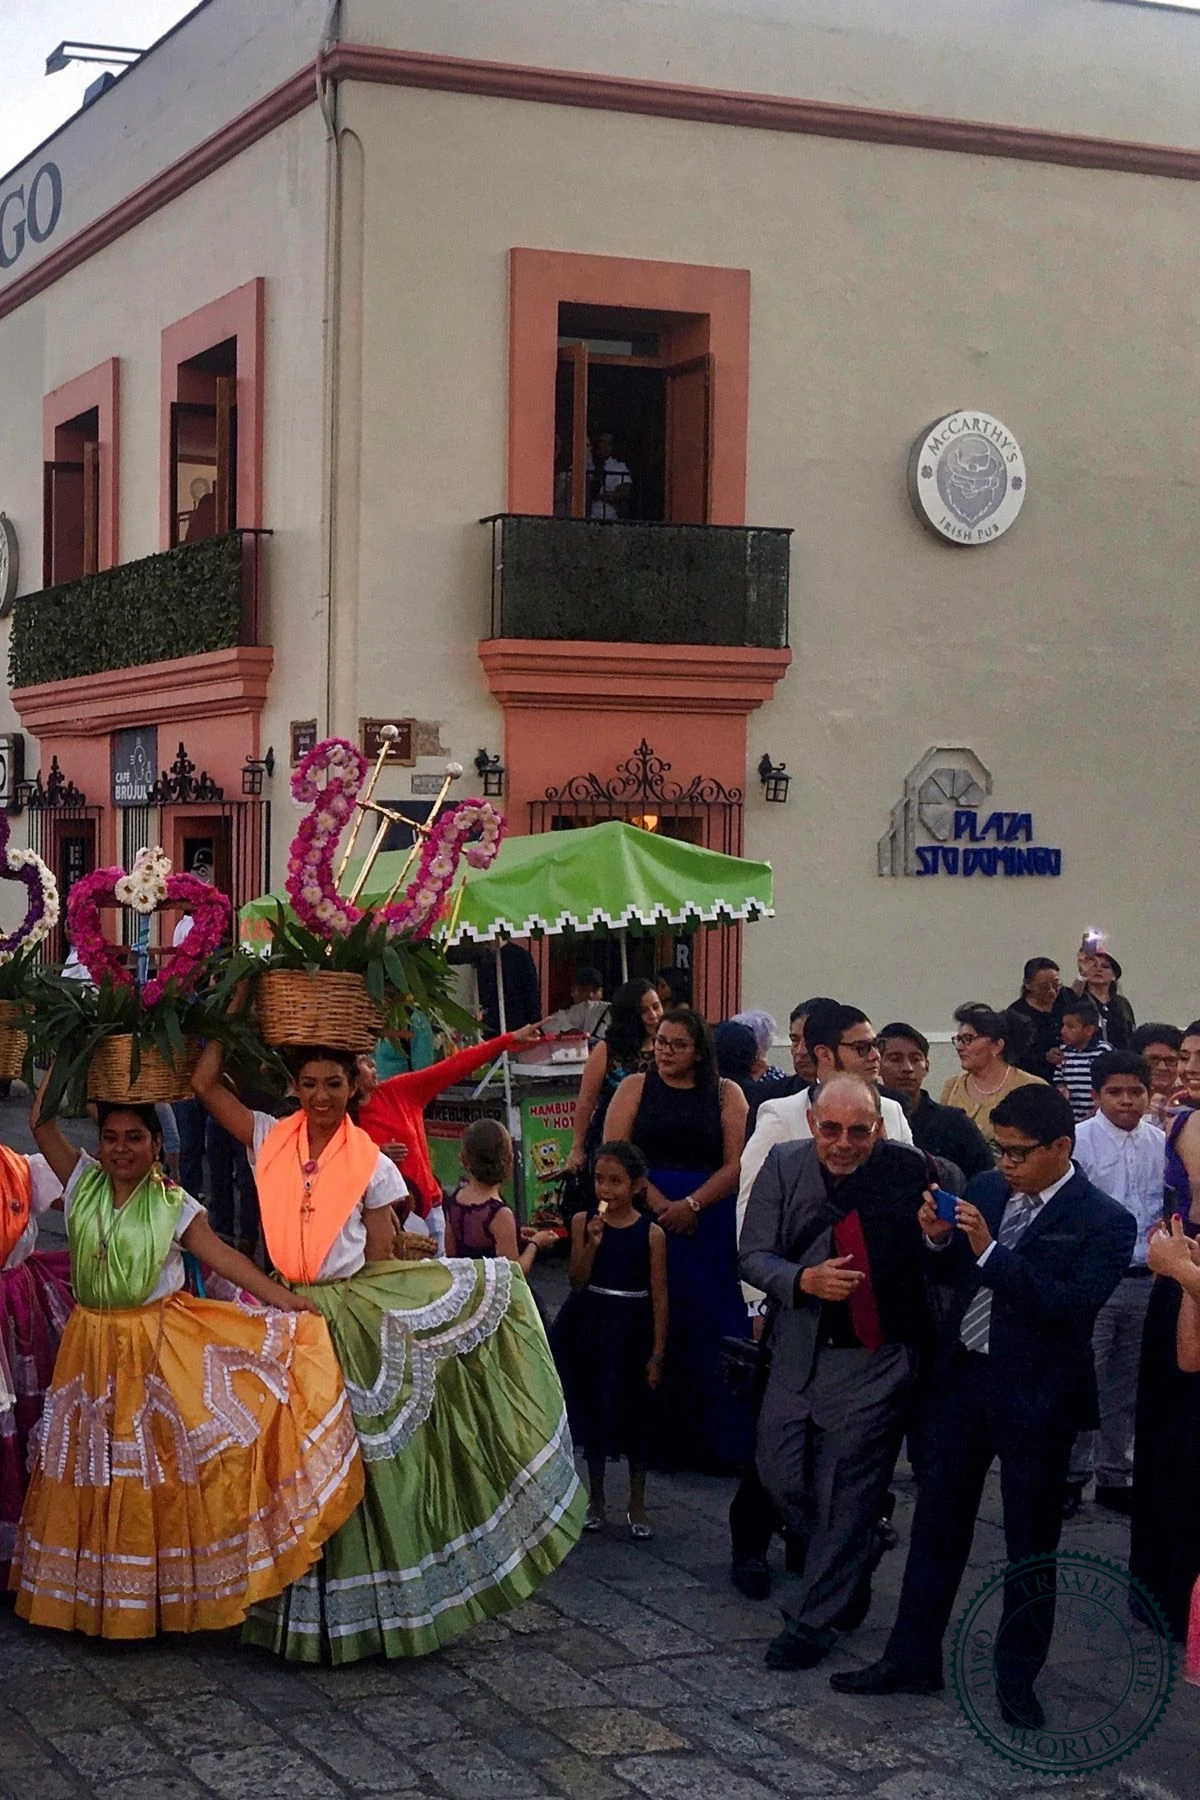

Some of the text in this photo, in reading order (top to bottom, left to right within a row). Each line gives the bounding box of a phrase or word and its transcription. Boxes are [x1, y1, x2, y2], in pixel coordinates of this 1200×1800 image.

[939, 516, 1000, 540] IRISH PUB
[115, 768, 130, 783] CAFÉ
[953, 810, 1033, 842] PLAZA
[915, 845, 1062, 877] STO DOMINGO
[543, 1117, 550, 1129] Y
